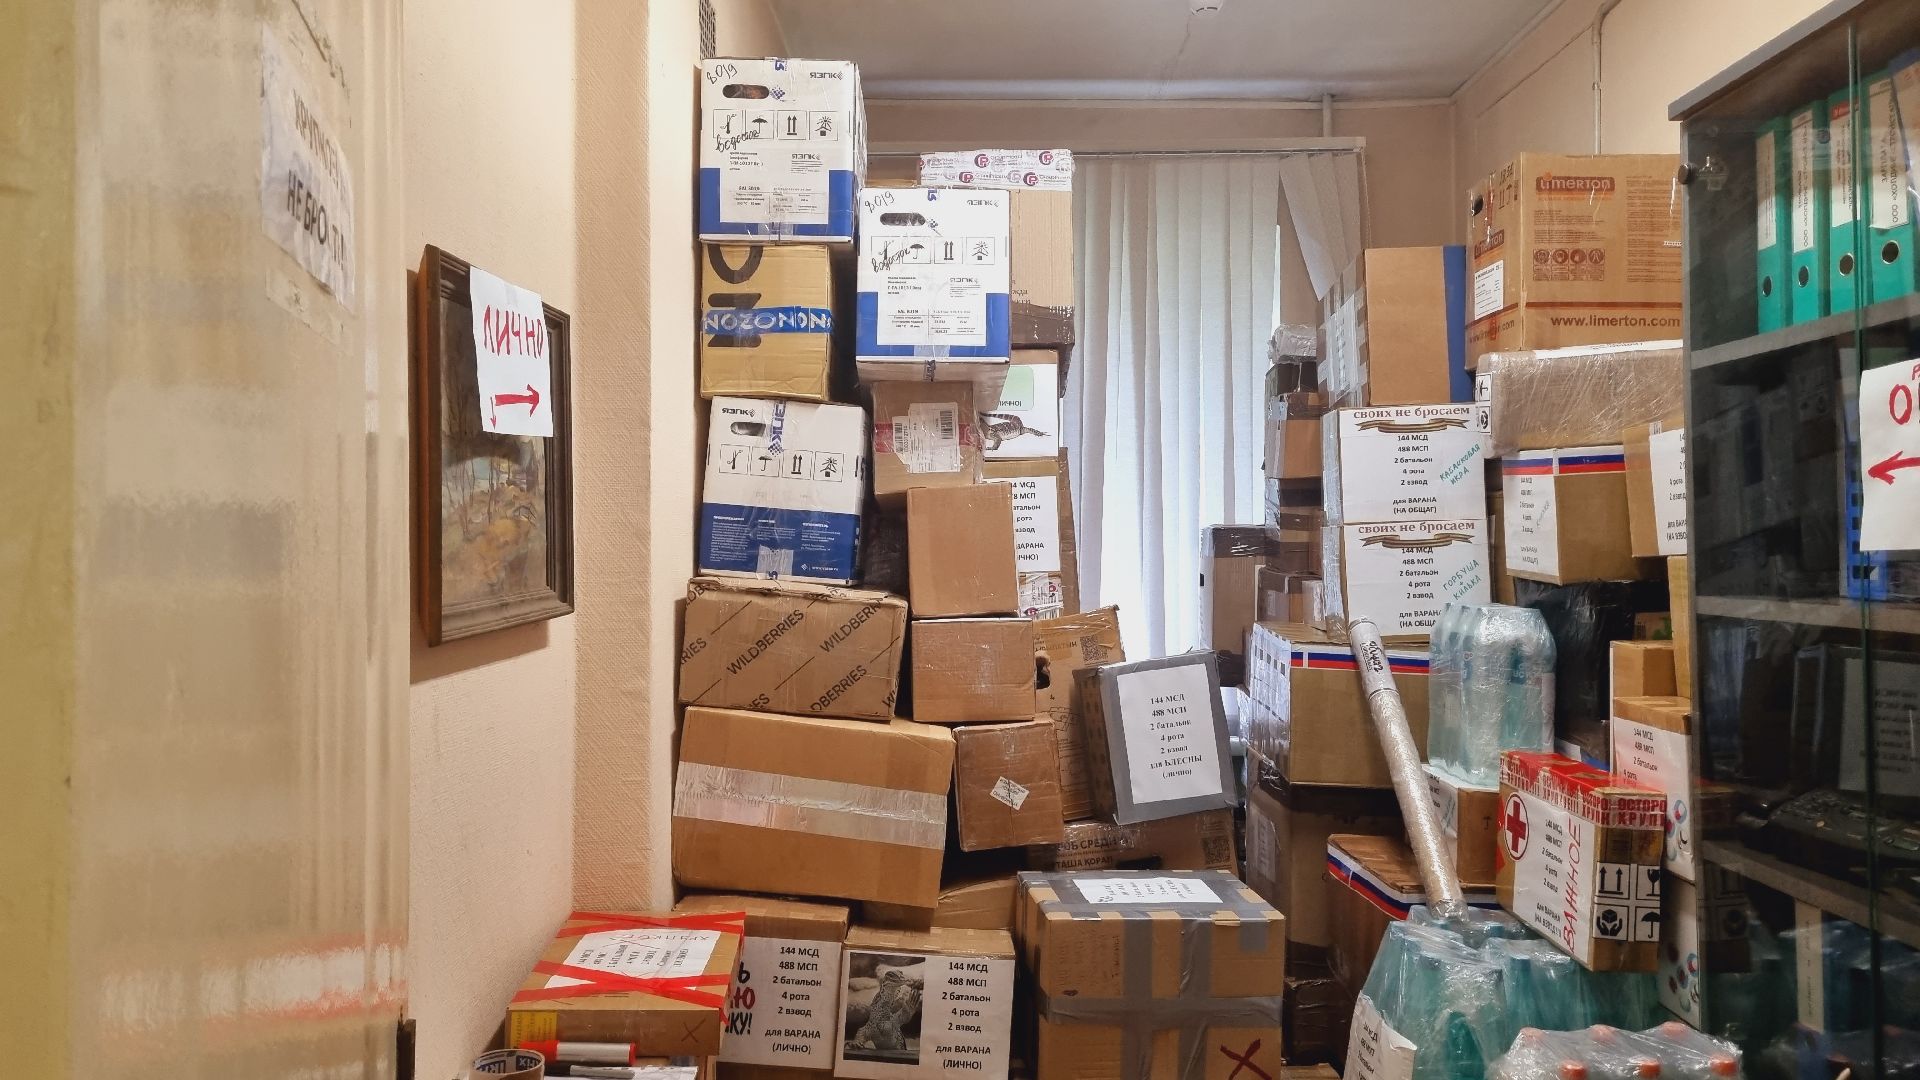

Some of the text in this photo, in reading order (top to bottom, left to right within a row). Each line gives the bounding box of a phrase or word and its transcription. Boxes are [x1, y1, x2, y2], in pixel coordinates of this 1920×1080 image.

[1550, 314, 1681, 327] www.limerton.com
[483, 304, 545, 360] ЛИЧНО
[1353, 406, 1470, 419] своих не бросаем
[1019, 481, 1036, 490] МСД
[1019, 492, 1036, 500] МСП
[1408, 496, 1437, 504] ВАРАНА
[1358, 521, 1475, 534] своих не бросаем
[1405, 569, 1439, 577] батальон
[1399, 621, 1413, 629] (НА
[726, 608, 804, 676] WILDBERRIES
[1150, 693, 1185, 704] 144 МСД
[1151, 706, 1187, 717] 488 МСП
[1167, 733, 1185, 742] рота
[1167, 745, 1188, 753] взвод
[1164, 754, 1203, 767] БЛЕСНЫ
[1563, 816, 1581, 954] ВАЖНОЕ
[780, 946, 820, 958] 144 МСД
[779, 961, 818, 971] 488 МСП
[948, 961, 988, 974] 144 МСД
[772, 976, 822, 987] 2 батальон
[947, 977, 987, 988] 488 МСП
[781, 991, 810, 1002] 4 рота
[941, 991, 991, 1002] 2 батальон
[777, 1006, 812, 1018] 2 взвод
[951, 1007, 980, 1018] 4 рота
[725, 1011, 753, 1036] КУ!
[947, 1022, 982, 1034] 2 взвод
[764, 1028, 821, 1039] для ВАРАНА
[772, 1042, 811, 1055] (ЛИЧНО)
[935, 1045, 991, 1055] для ВАРАНА
[943, 1059, 982, 1071] (ЛИЧНО)
